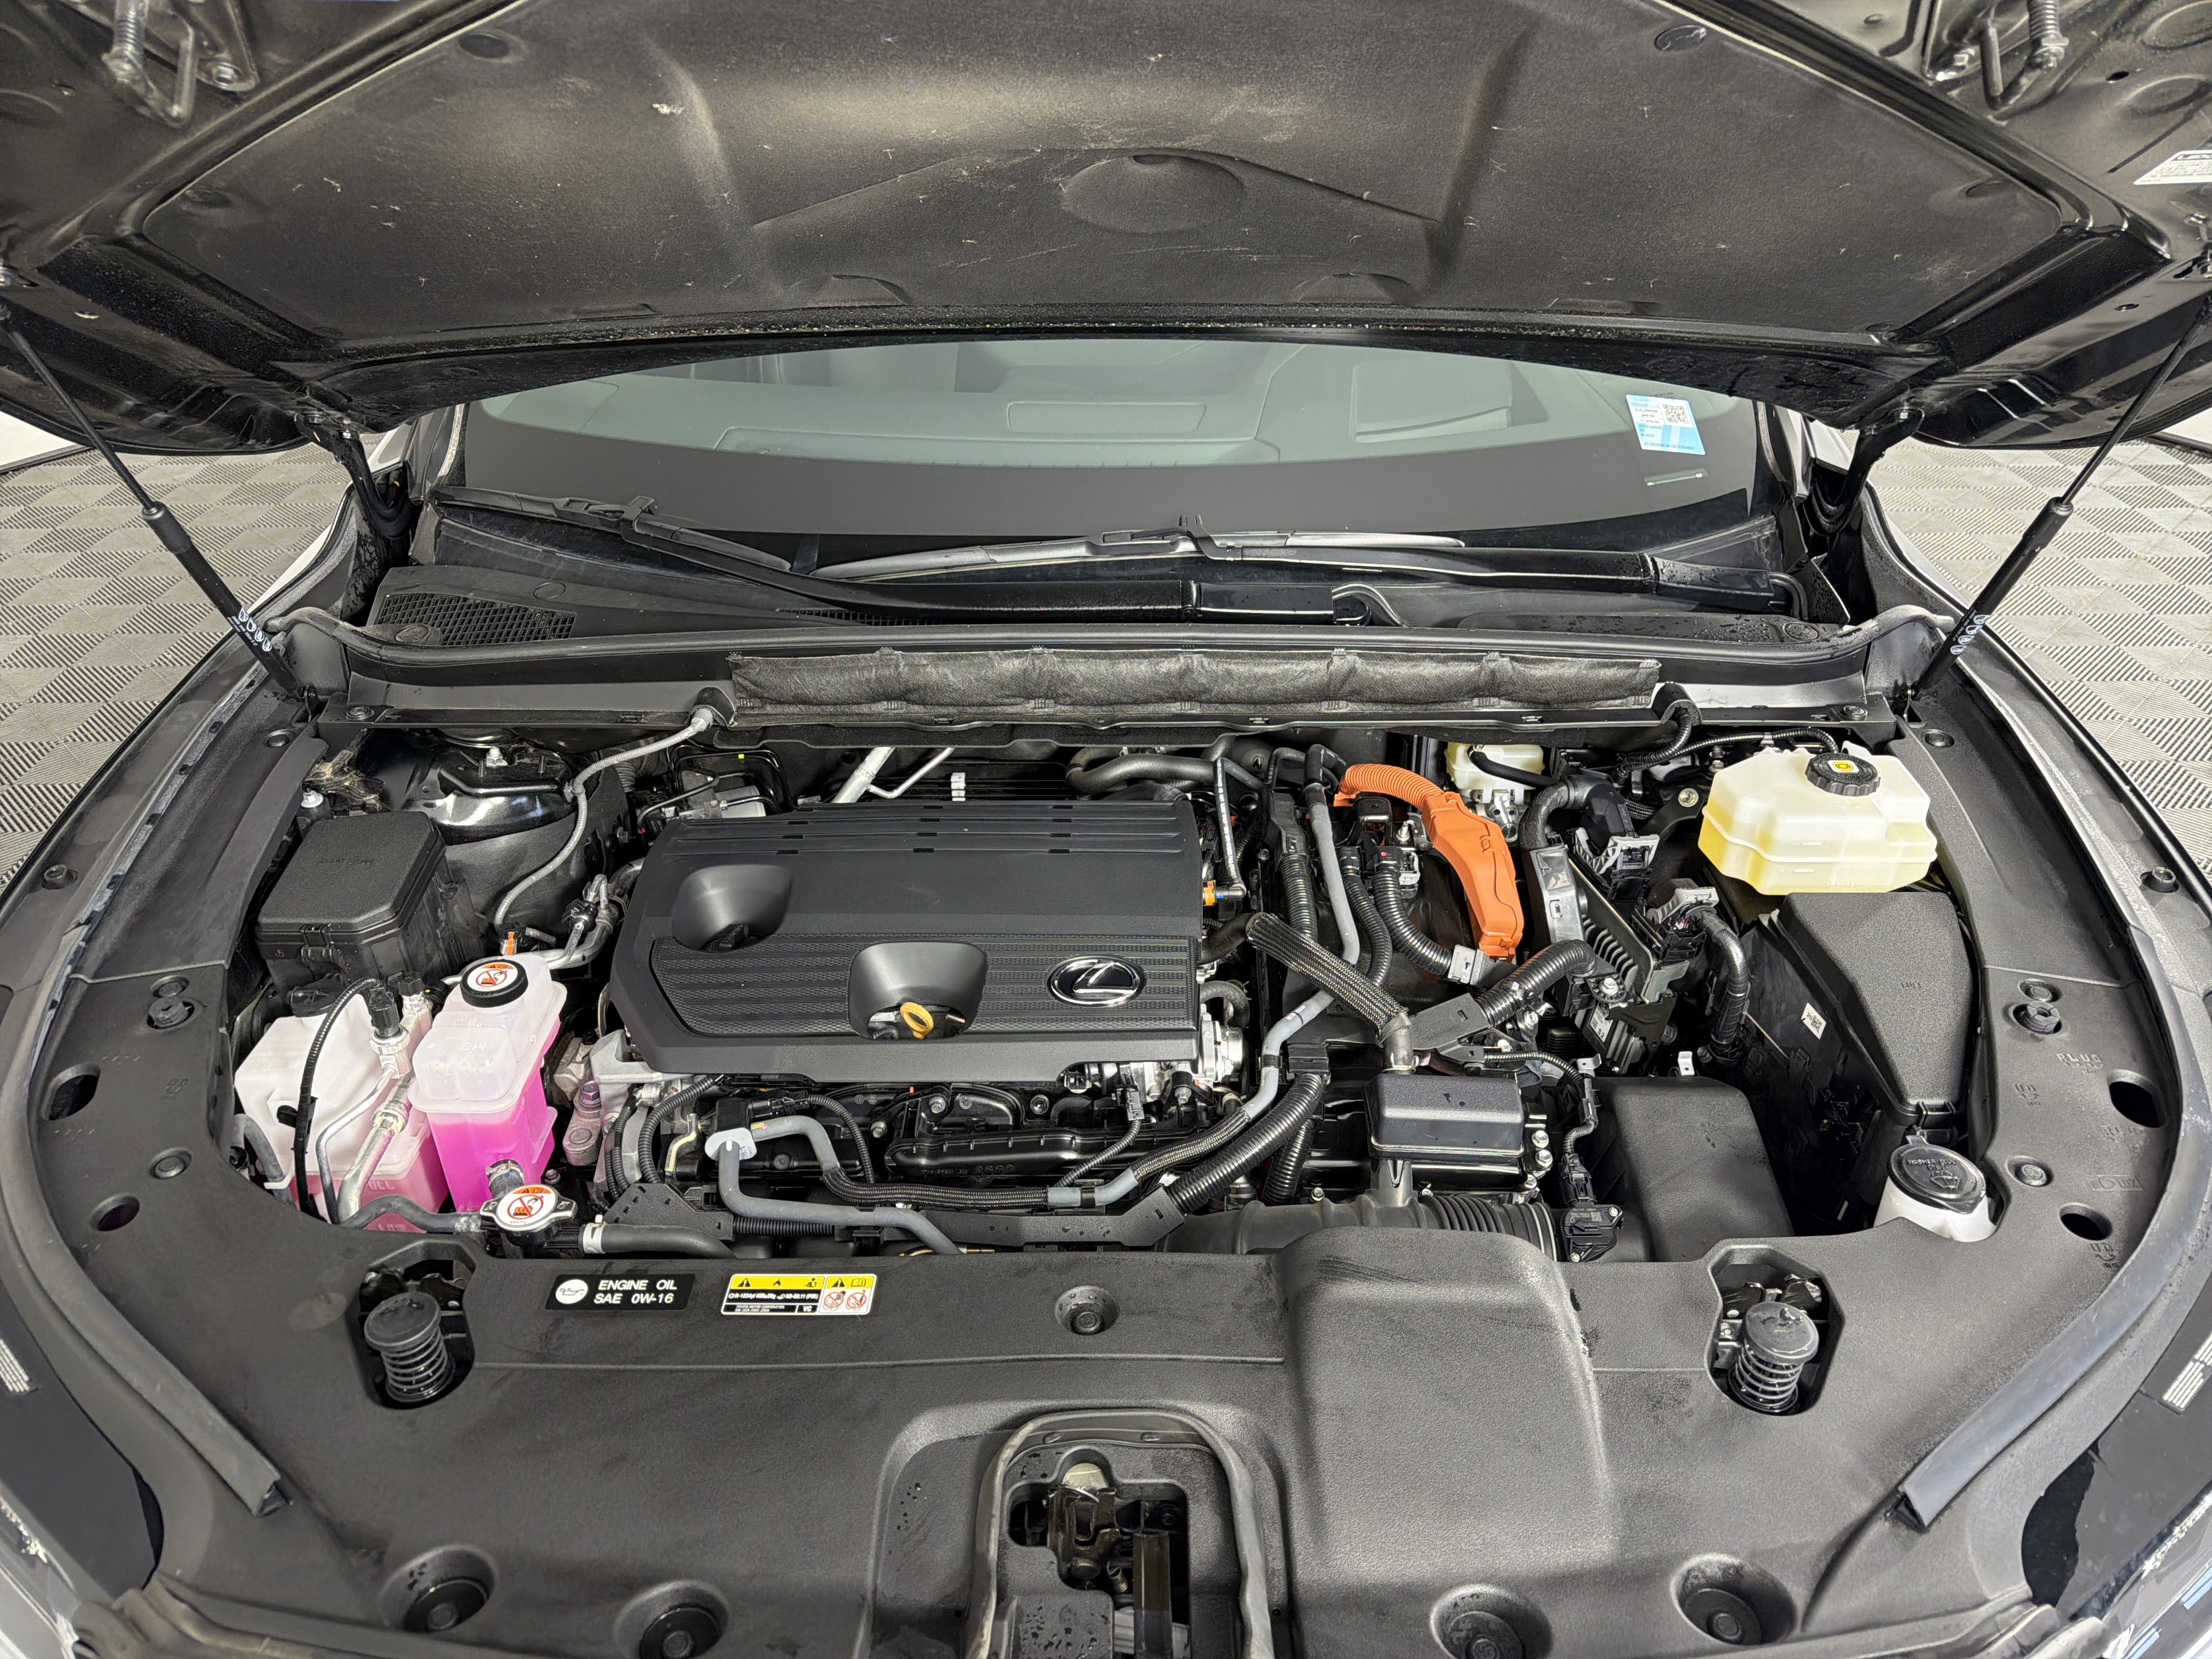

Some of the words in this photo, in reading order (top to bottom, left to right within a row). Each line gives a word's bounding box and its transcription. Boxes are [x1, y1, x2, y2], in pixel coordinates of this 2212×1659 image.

[598, 1280, 649, 1290] ENGINE
[656, 1280, 678, 1290] OIL
[594, 1293, 623, 1304] SAE
[631, 1293, 674, 1304] 0W-16
